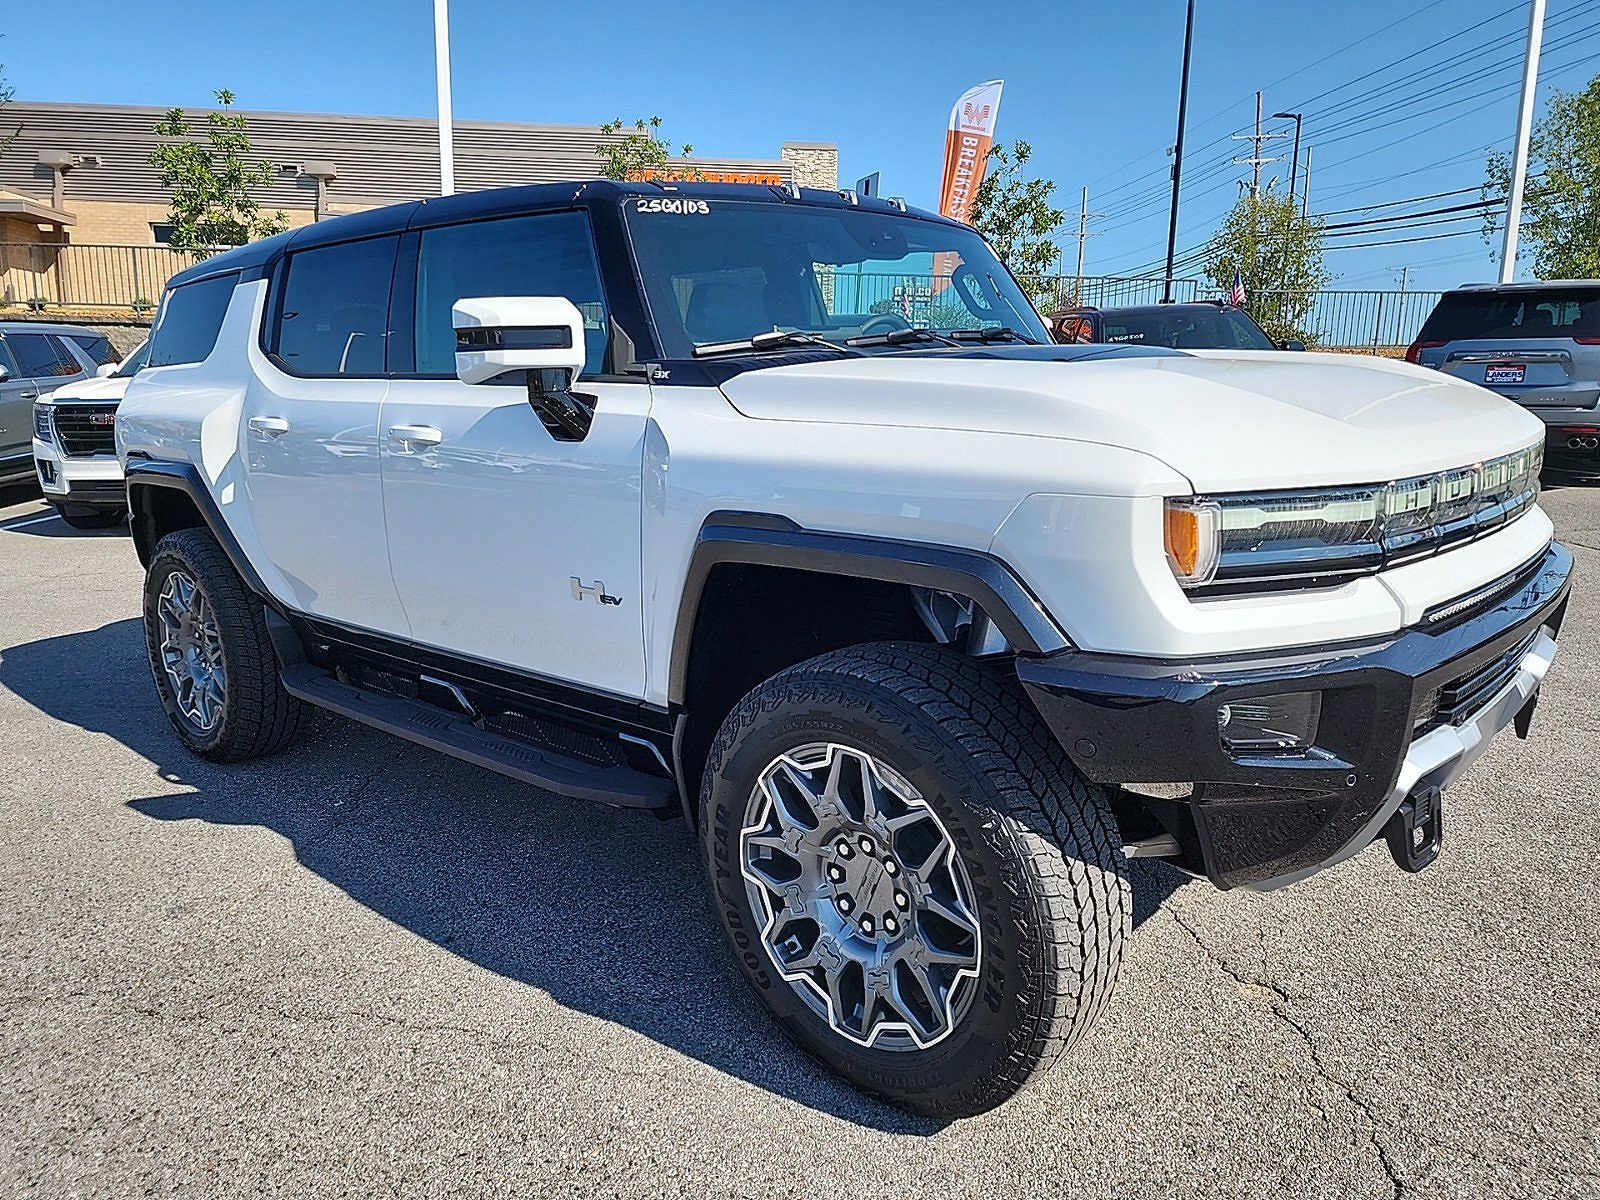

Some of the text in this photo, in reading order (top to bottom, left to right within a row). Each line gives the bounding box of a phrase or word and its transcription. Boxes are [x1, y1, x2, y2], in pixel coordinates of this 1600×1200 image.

[636, 199, 710, 215] 25G0103
[653, 370, 671, 379] 3X
[713, 803, 772, 991] GOODYEAR
[934, 793, 1005, 1013] WRANGLER
